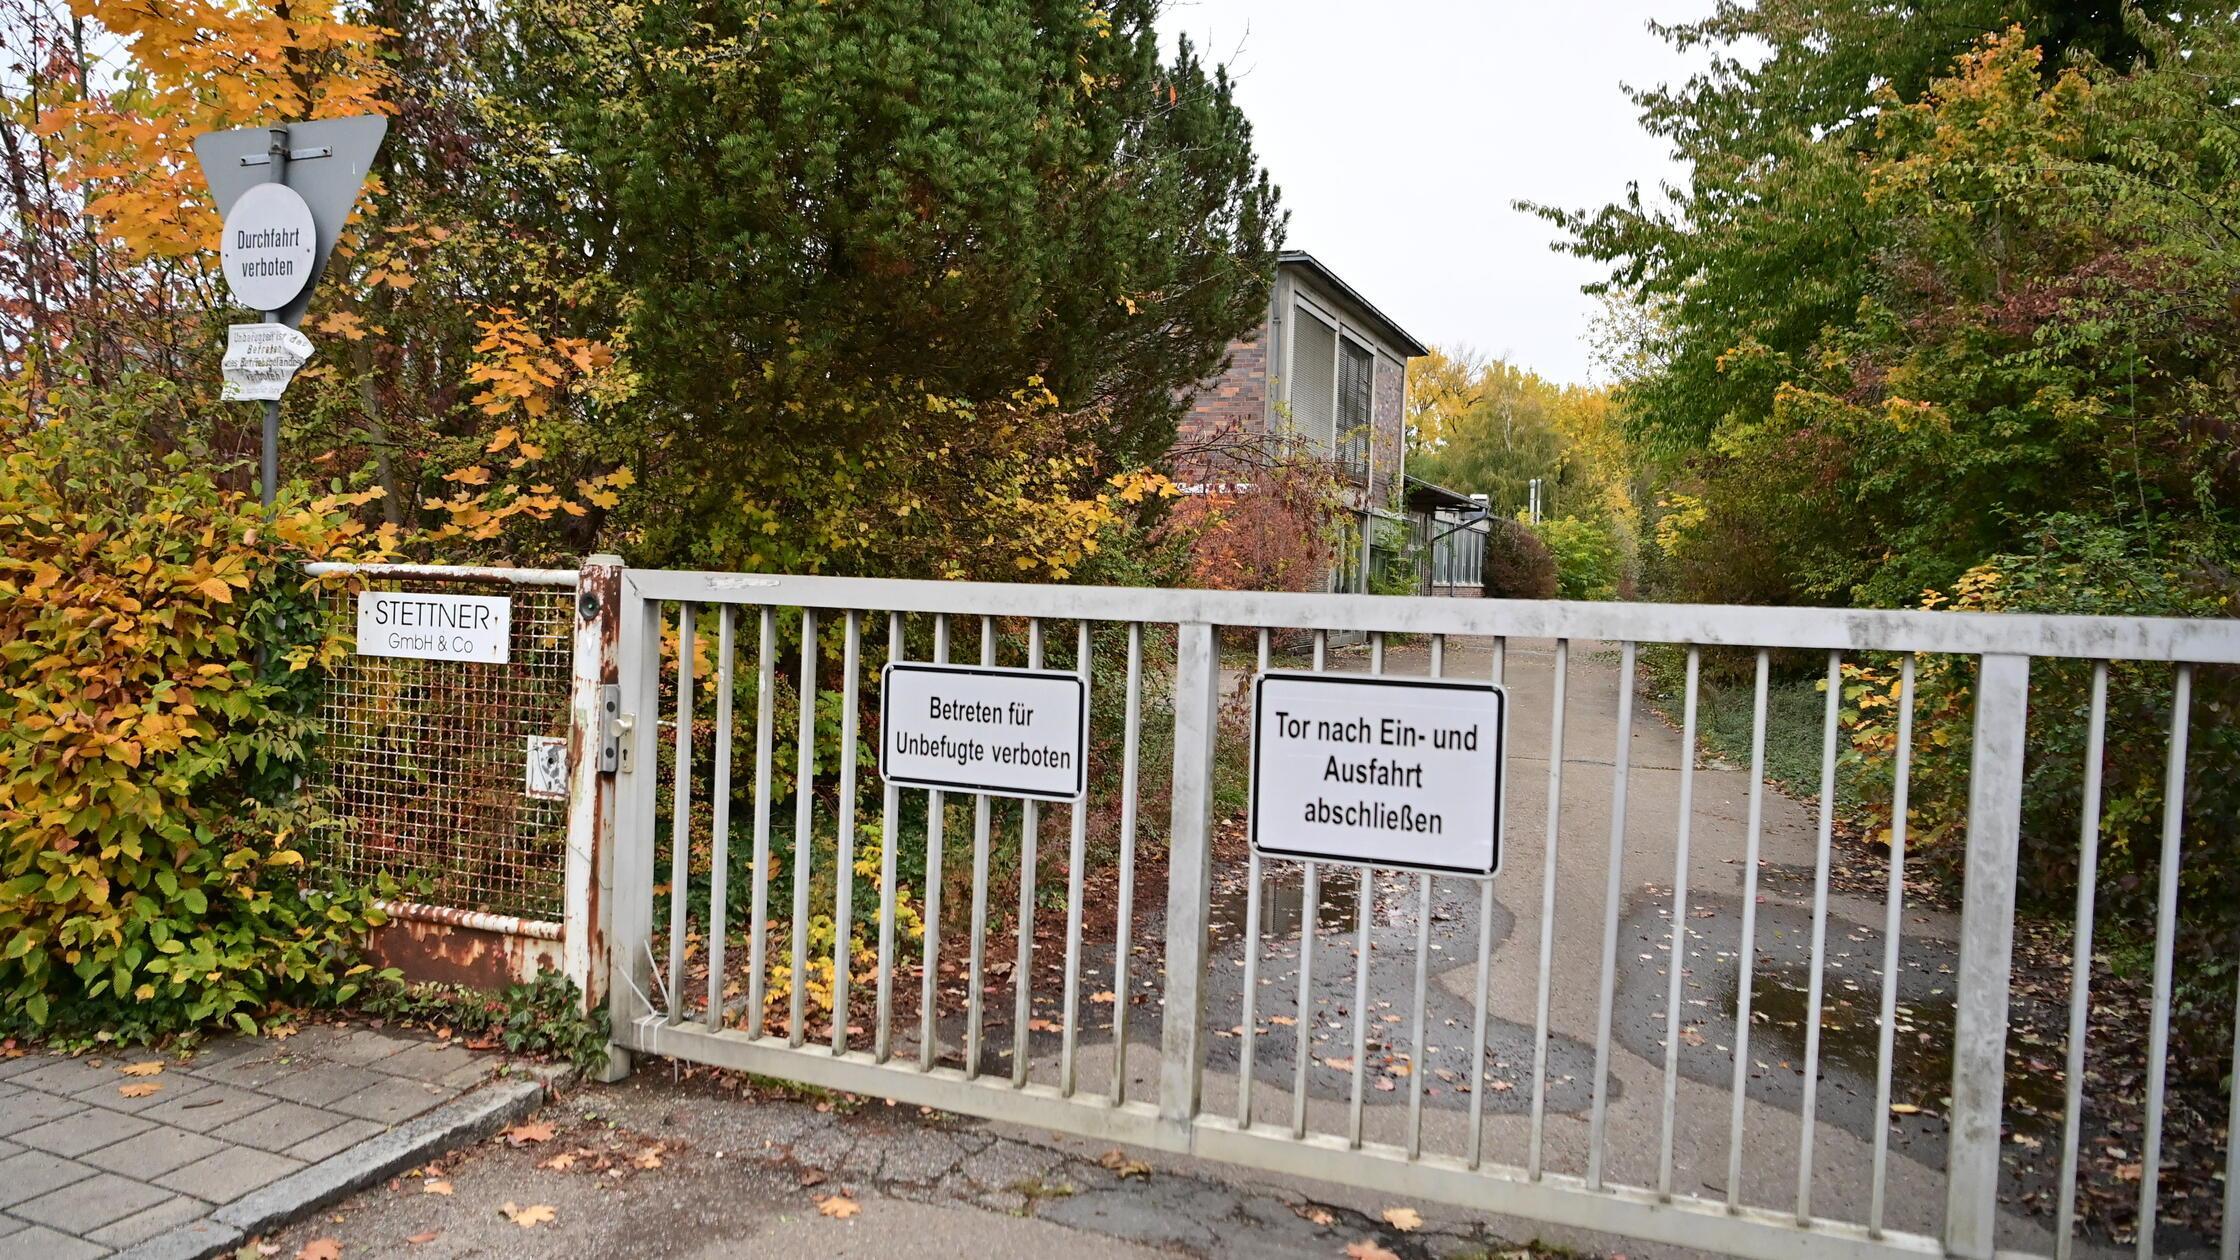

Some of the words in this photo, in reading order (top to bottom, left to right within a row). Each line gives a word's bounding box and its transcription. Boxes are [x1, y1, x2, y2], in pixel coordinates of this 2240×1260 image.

[237, 228, 300, 250] Durchfahrt
[241, 259, 294, 278] verboten
[375, 600, 490, 630] STETTNER
[388, 632, 433, 651] GmbH
[437, 635, 448, 652] &
[452, 636, 474, 654] Co
[929, 696, 1002, 724] Betreten
[1009, 702, 1034, 726] für
[1275, 711, 1311, 740] Tor
[1318, 717, 1371, 744] nach
[1380, 718, 1426, 747] Ein-
[1433, 724, 1478, 752] und
[896, 731, 984, 766] Unbefugte
[992, 742, 1071, 770] verboten
[1324, 755, 1423, 788] Ausfahrt
[1304, 797, 1442, 834] abschließen
